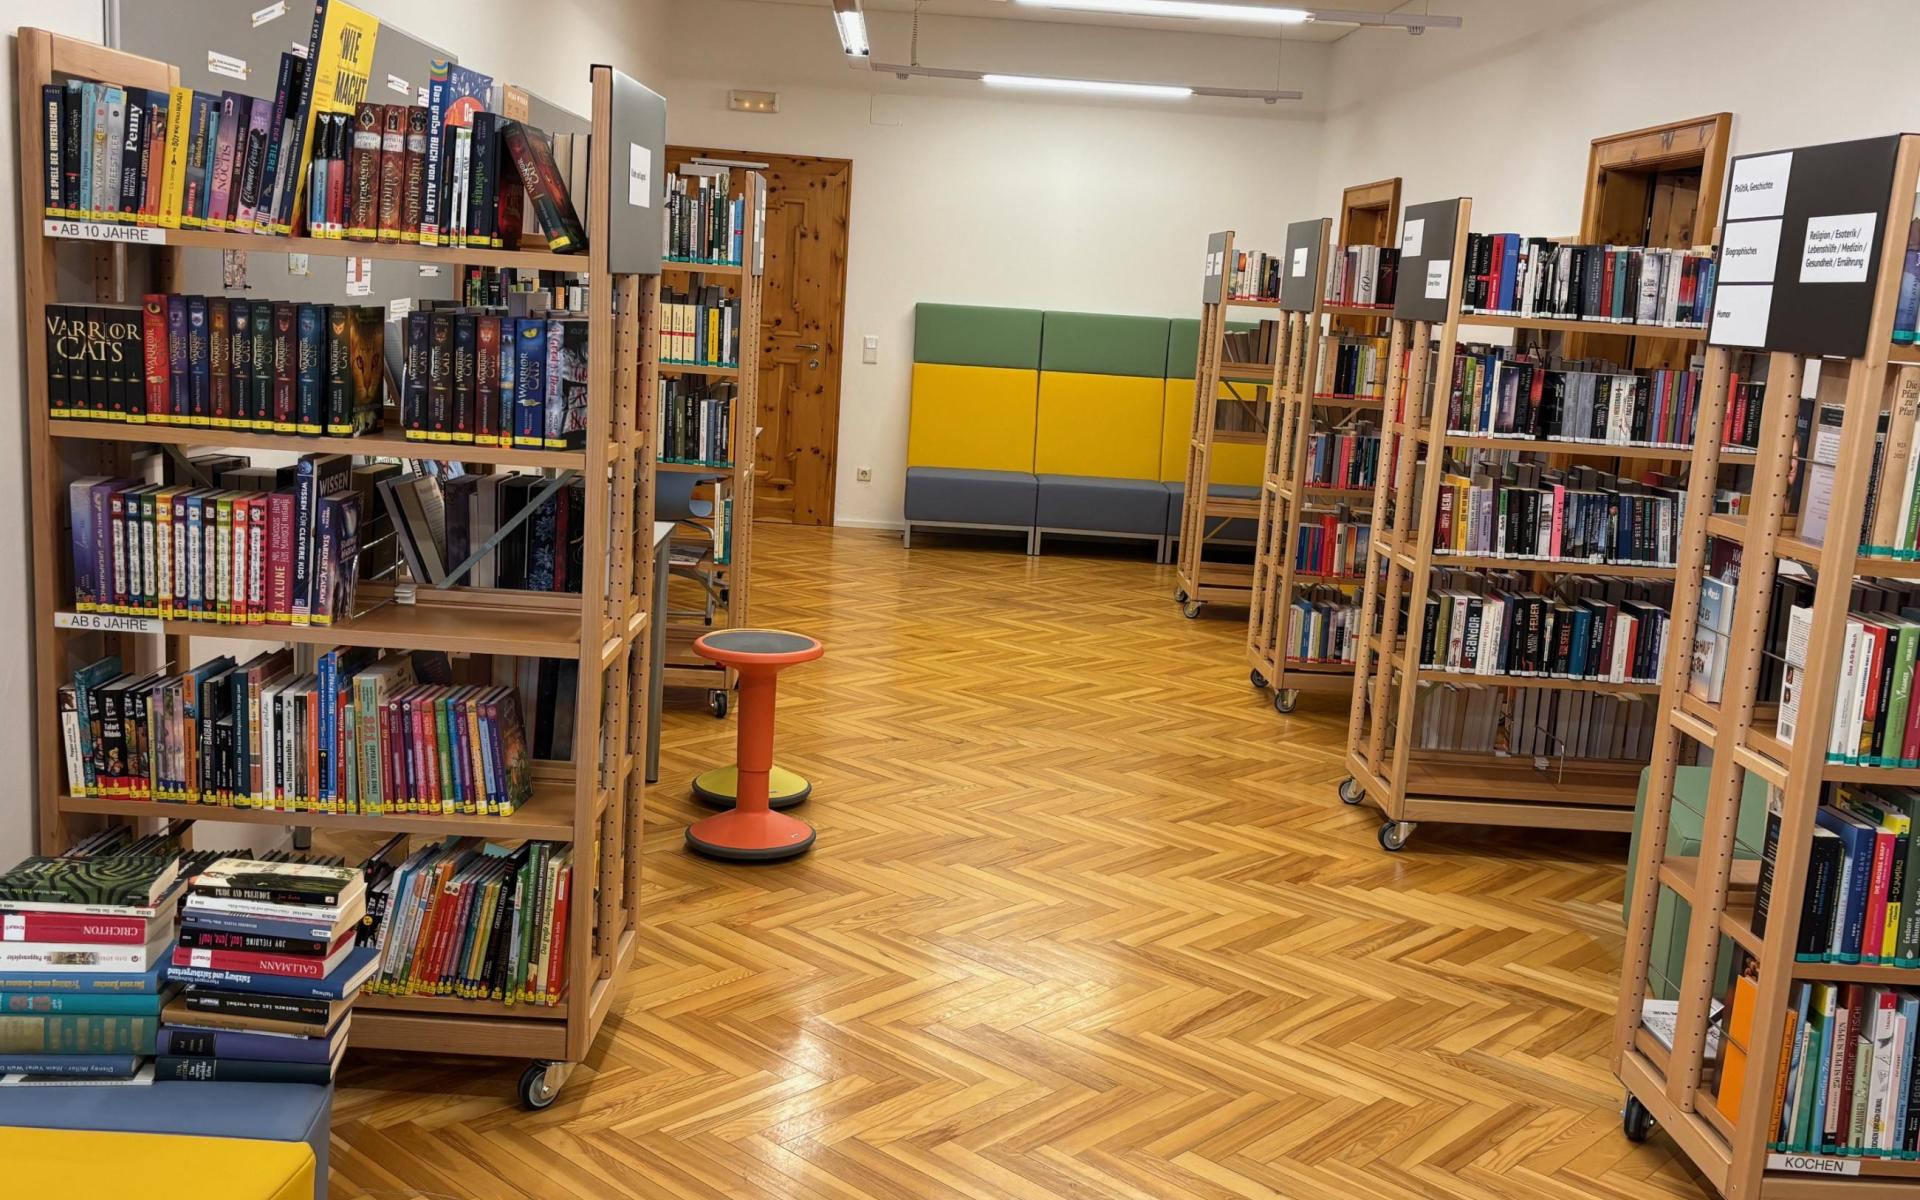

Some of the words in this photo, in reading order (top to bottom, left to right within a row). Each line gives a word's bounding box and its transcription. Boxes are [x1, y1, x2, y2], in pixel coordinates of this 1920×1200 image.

[341, 28, 362, 63] WIE
[432, 85, 443, 103] Das
[125, 103, 142, 152] Penny
[430, 105, 441, 135] große
[267, 143, 278, 173] TIERE
[429, 137, 439, 161] BUCH
[49, 152, 58, 166] DER
[50, 166, 59, 188] SPIELE
[428, 163, 437, 181] von
[50, 189, 60, 200] DIE
[1750, 181, 1774, 191] Geschichte
[426, 182, 437, 213] ALLEM
[61, 226, 80, 236] AB
[84, 225, 99, 238] 10
[103, 226, 150, 241] JAHRE
[1809, 230, 1831, 240] Religion
[1835, 229, 1857, 239] Esoterik
[1725, 247, 1758, 256] Biographisches
[1808, 244, 1837, 254] Lebenshilfe
[1842, 243, 1863, 253] Medizin
[1805, 258, 1833, 268] Gesundheit
[1837, 257, 1864, 268] Ernährung
[1716, 310, 1731, 318] Humor
[57, 336, 123, 362] CATS
[518, 352, 528, 399] WARRIOR
[527, 360, 540, 391] CATS
[319, 470, 349, 498] WISSEN
[300, 481, 308, 510] WISSEN
[1441, 493, 1452, 511] AERA
[299, 512, 307, 527] FÜR
[298, 527, 307, 561] CLEVERE
[321, 534, 331, 571] STARDUST
[297, 561, 305, 580] KIDS
[275, 565, 285, 598] KLUNE
[319, 571, 328, 605] ACADEMY
[71, 616, 90, 627] AB
[92, 616, 101, 628] 6
[104, 617, 148, 631] JAHRE
[204, 719, 212, 745] BAOBAB
[232, 889, 243, 898] AND
[83, 925, 138, 936] CRICHTON
[1903, 917, 1912, 944] Essbare
[212, 972, 224, 980] und
[259, 960, 318, 975] GALLMANN
[225, 972, 251, 983] Salzburg
[1845, 1052, 1856, 1091] FREUNDE
[1854, 1101, 1865, 1134] KAMINER
[1785, 1157, 1844, 1173] KOCHEN
